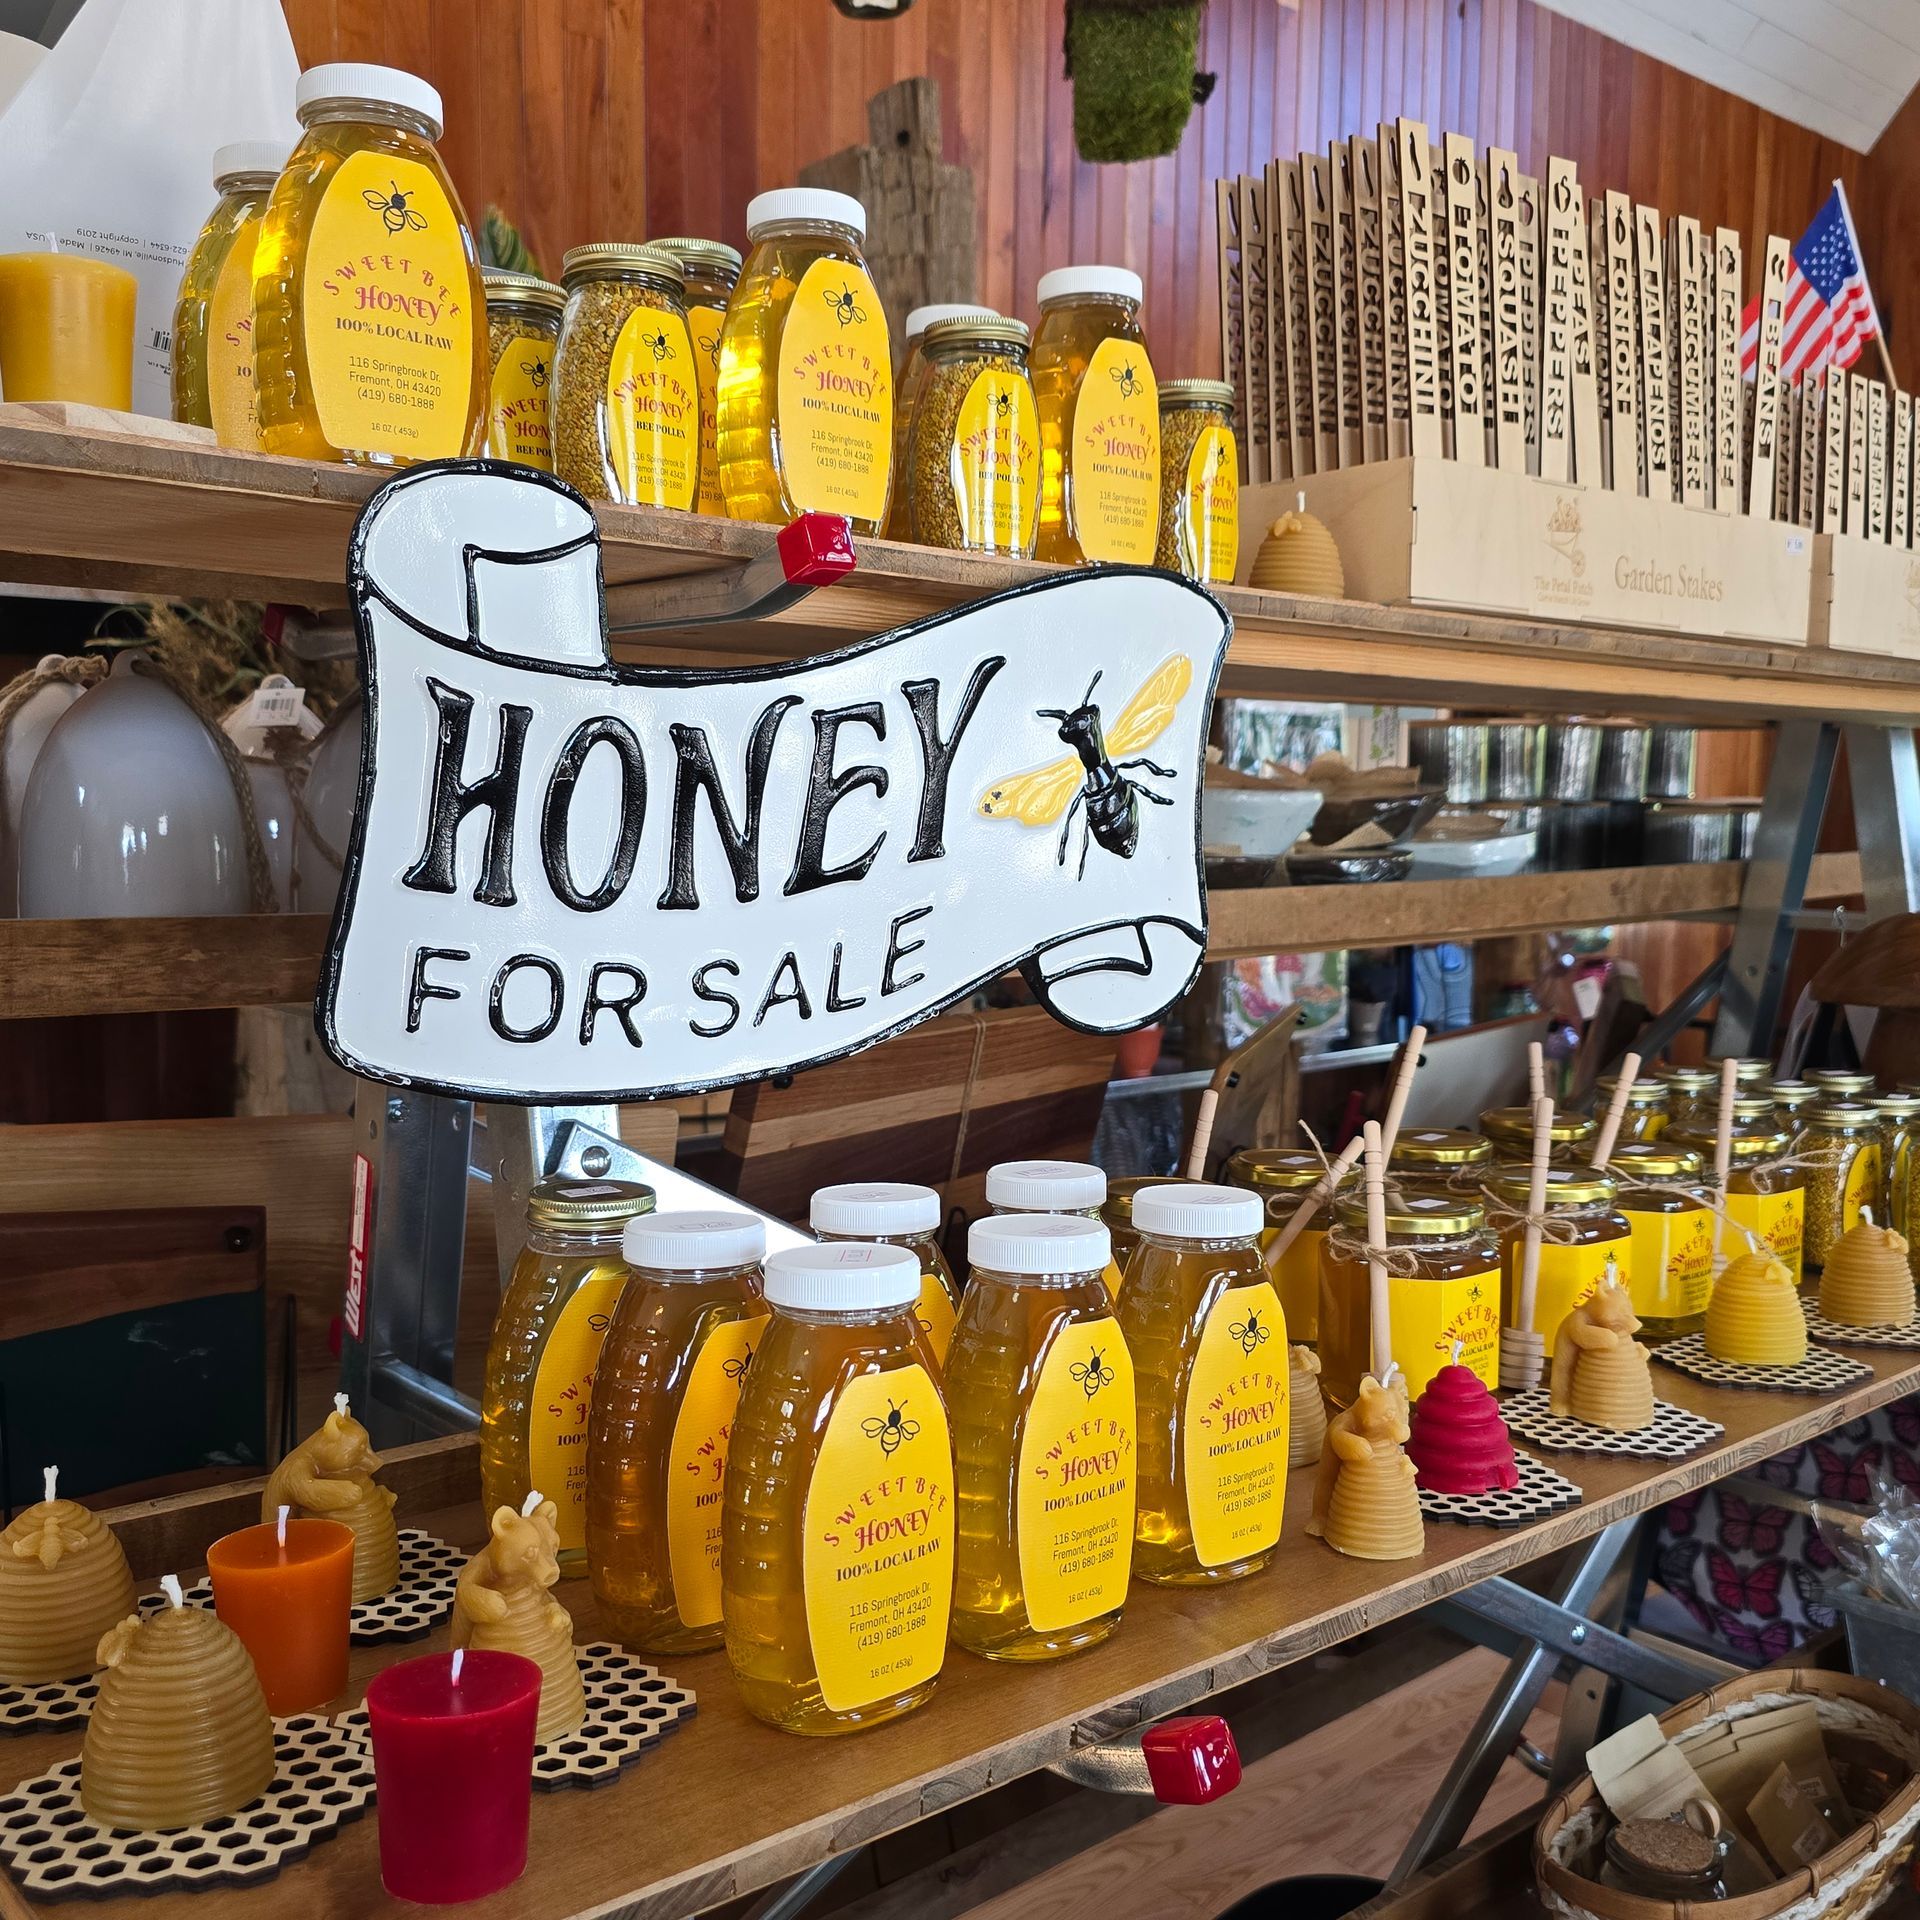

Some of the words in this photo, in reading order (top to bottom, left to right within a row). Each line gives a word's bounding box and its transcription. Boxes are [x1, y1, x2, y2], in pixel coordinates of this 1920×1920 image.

[26, 232, 46, 241] USA
[60, 238, 85, 249] Made
[76, 228, 97, 238] 2019
[95, 244, 120, 255] 49426
[100, 233, 139, 244] copyright
[150, 242, 190, 254] -622-6344
[122, 250, 132, 258] MI
[136, 253, 184, 267] Hudsonville,
[323, 255, 412, 296] SWEET
[421, 270, 462, 319] BEE
[354, 285, 444, 326] HONEY
[1360, 219, 1384, 420] ZUCCHINI
[1388, 211, 1410, 416] ZUCCHINI
[1407, 203, 1434, 410] ZUCCHINI
[1453, 220, 1478, 408] TOMATO
[1571, 263, 1591, 366] PEAS
[336, 317, 374, 335] 100%
[376, 324, 422, 344] LOCAL
[425, 334, 454, 350] RAW
[1313, 237, 1337, 425] ZUCCHINI
[1497, 231, 1520, 420] SQUASH
[1546, 244, 1569, 437] PEPPERS
[1612, 266, 1631, 402] ONION
[1520, 253, 1535, 445] PEPPERS
[349, 356, 370, 369] 116
[372, 359, 428, 380] Springbrook
[430, 370, 441, 382] Dr.
[350, 371, 393, 388] Fremont,
[396, 379, 409, 390] OH
[412, 382, 441, 397] 43420
[794, 345, 856, 380] SWEET
[862, 356, 887, 398] BEE
[816, 370, 876, 403] HONEY
[1644, 286, 1666, 468] JALAPENOS
[1682, 288, 1701, 486] CUCUMBER
[1759, 318, 1780, 448] BEANS
[358, 387, 386, 404] (419)
[389, 391, 435, 410] 680-1888
[613, 372, 669, 404] SWEET
[671, 377, 695, 412] BEE
[1719, 300, 1735, 483] CABBAGE
[371, 422, 380, 431] 16
[382, 424, 392, 433] OZ
[493, 398, 548, 429] SWEET
[634, 396, 686, 424] HONEY
[802, 397, 830, 412] 100%
[831, 402, 862, 419] LOCAL
[863, 409, 881, 423] RAW
[514, 420, 550, 440] HON
[636, 421, 655, 432] BEE
[656, 423, 686, 439] POLLEN
[811, 429, 826, 440] 116
[828, 433, 865, 449] Springbrook
[959, 426, 1009, 458] SWEET
[1085, 414, 1135, 448] SWEET
[1851, 391, 1864, 500] SAGE
[516, 444, 534, 455] BEE
[811, 442, 842, 457] Fremont,
[844, 448, 853, 458] OH
[854, 451, 873, 463] 43420
[817, 456, 837, 470] (419)
[838, 461, 869, 475] 680-1888
[978, 449, 1025, 471] HONEY
[1103, 439, 1149, 462] HONEY
[1871, 397, 1882, 531] ROSEMARY
[996, 472, 1025, 486] POLLEN
[1615, 555, 1673, 596] Garden
[1678, 564, 1723, 602] Stakes
[401, 656, 1007, 912] HONEY
[407, 945, 649, 1049] FOR
[689, 904, 936, 1040] SALE
[1434, 1304, 1482, 1354] SWEET
[548, 1372, 594, 1417] SWE
[1200, 1372, 1261, 1429] SWEET
[1265, 1374, 1287, 1406] BEE
[1222, 1399, 1278, 1435] HONEY
[686, 1424, 732, 1477] SWE
[1035, 1418, 1103, 1480] SWEET
[1109, 1420, 1133, 1456] BEE
[1208, 1440, 1236, 1458] 100%
[1236, 1432, 1267, 1452] LOCAL
[1266, 1425, 1283, 1443] RAW
[1059, 1446, 1123, 1487] HONEY
[1217, 1475, 1232, 1488] 116
[1233, 1465, 1267, 1484] Springbrook
[1044, 1492, 1074, 1513] 100%
[1075, 1484, 1109, 1506] LOCAL
[1109, 1476, 1127, 1497] RAW
[1217, 1486, 1247, 1501] Fremont,
[1248, 1482, 1257, 1493] OH
[1258, 1475, 1276, 1489] 43420
[1223, 1500, 1242, 1516] (419)
[1243, 1490, 1272, 1509] 680-1888
[824, 1476, 907, 1548] SWEET
[915, 1476, 948, 1513] BEE
[853, 1504, 935, 1553] HONEY
[1053, 1532, 1070, 1546] 116
[1071, 1520, 1110, 1541] Springbrook
[1111, 1517, 1119, 1529] Dr.
[1053, 1542, 1086, 1561] Fremont,
[1088, 1538, 1097, 1550] OH
[1098, 1532, 1119, 1547] 43420
[835, 1562, 872, 1583] 100%
[874, 1549, 916, 1574] LOCAL
[917, 1536, 941, 1562] RAW
[1059, 1557, 1081, 1577] (419)
[1082, 1548, 1114, 1569] 680-1888
[849, 1603, 868, 1618] 116
[871, 1586, 920, 1612] Springbrook
[921, 1581, 932, 1596] Dr.
[849, 1615, 890, 1634] Fremont,
[893, 1609, 905, 1622] OH
[906, 1596, 932, 1615] 43420
[857, 1629, 884, 1651] (419)
[886, 1615, 927, 1641] 680-1888
[870, 1668, 880, 1679] 16
[880, 1664, 889, 1677] OZ
